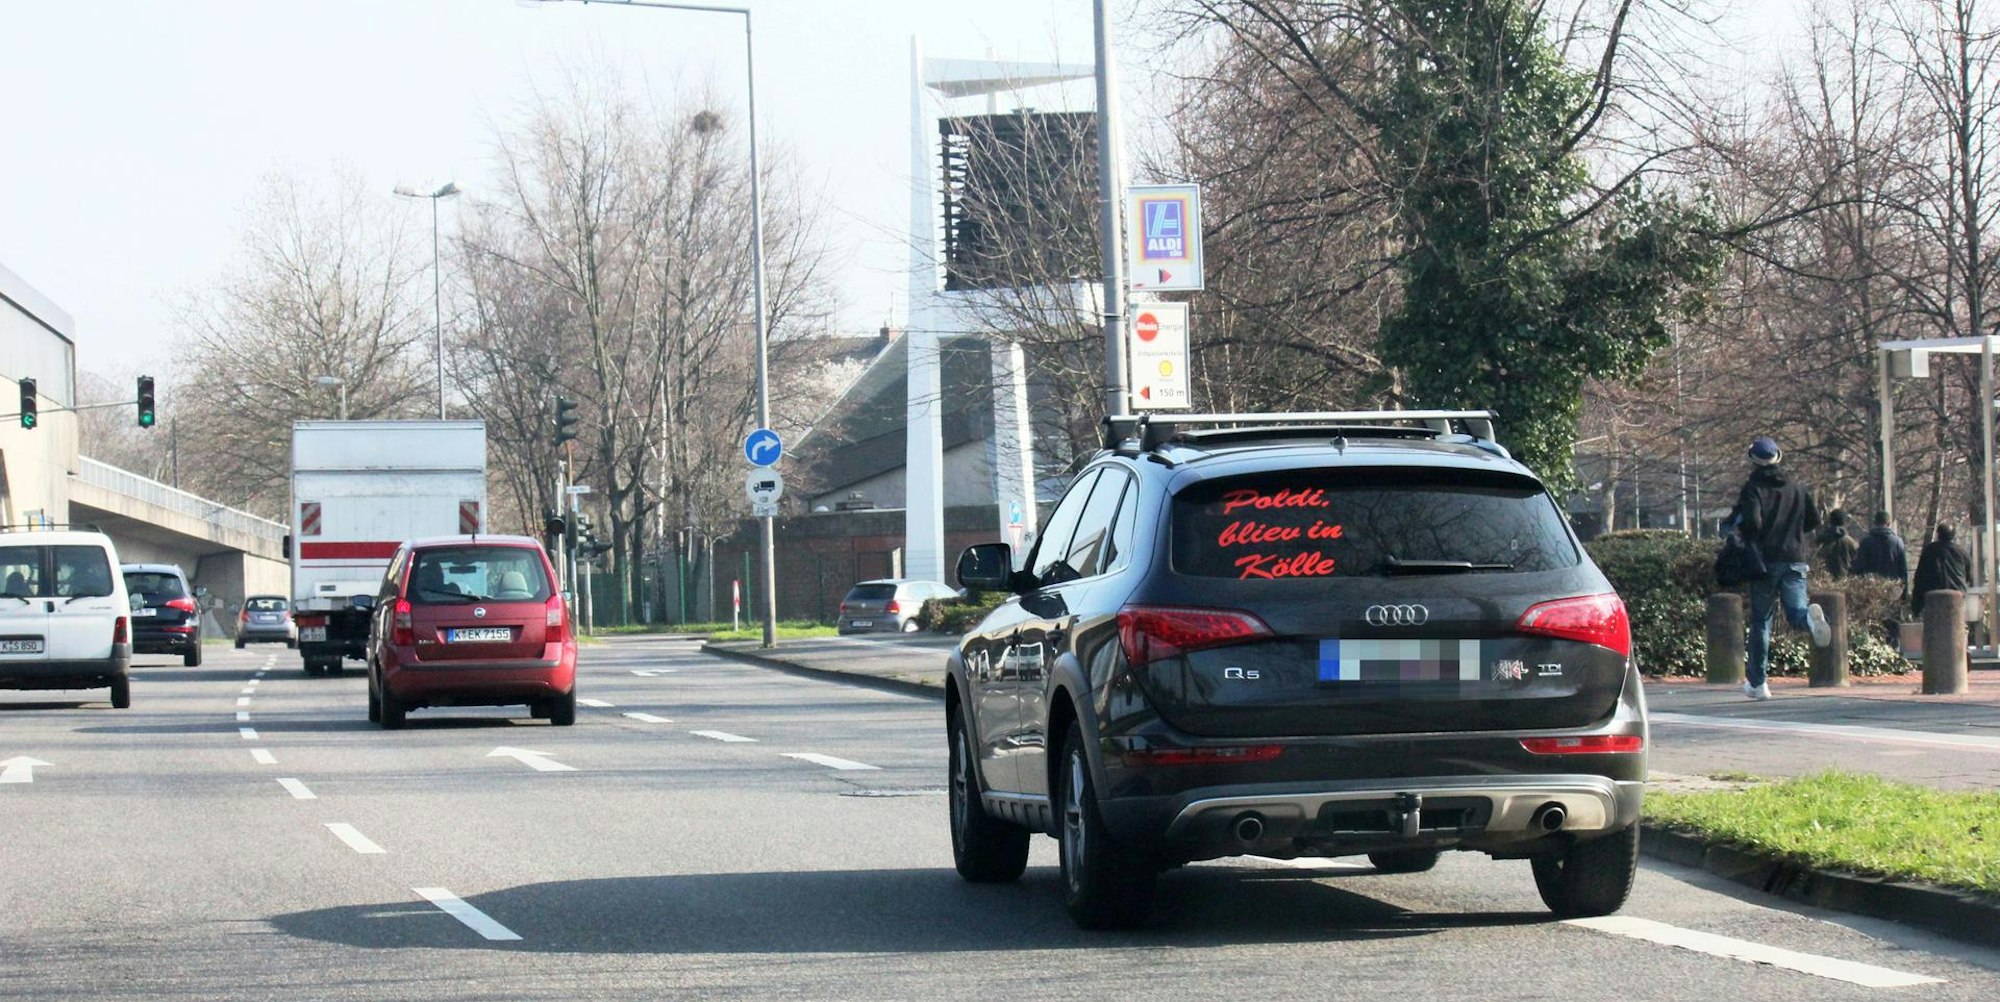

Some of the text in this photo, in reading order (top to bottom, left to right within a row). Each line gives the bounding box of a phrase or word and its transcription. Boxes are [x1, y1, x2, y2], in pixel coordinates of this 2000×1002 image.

[1148, 238, 1182, 251] ALDI
[1159, 388, 1174, 398] 150
[1218, 520, 1343, 547] bliev in
[1235, 551, 1335, 580] Kölle
[484, 629, 509, 640] 7155
[1224, 667, 1260, 680] Q5
[1538, 663, 1562, 672] TDI
